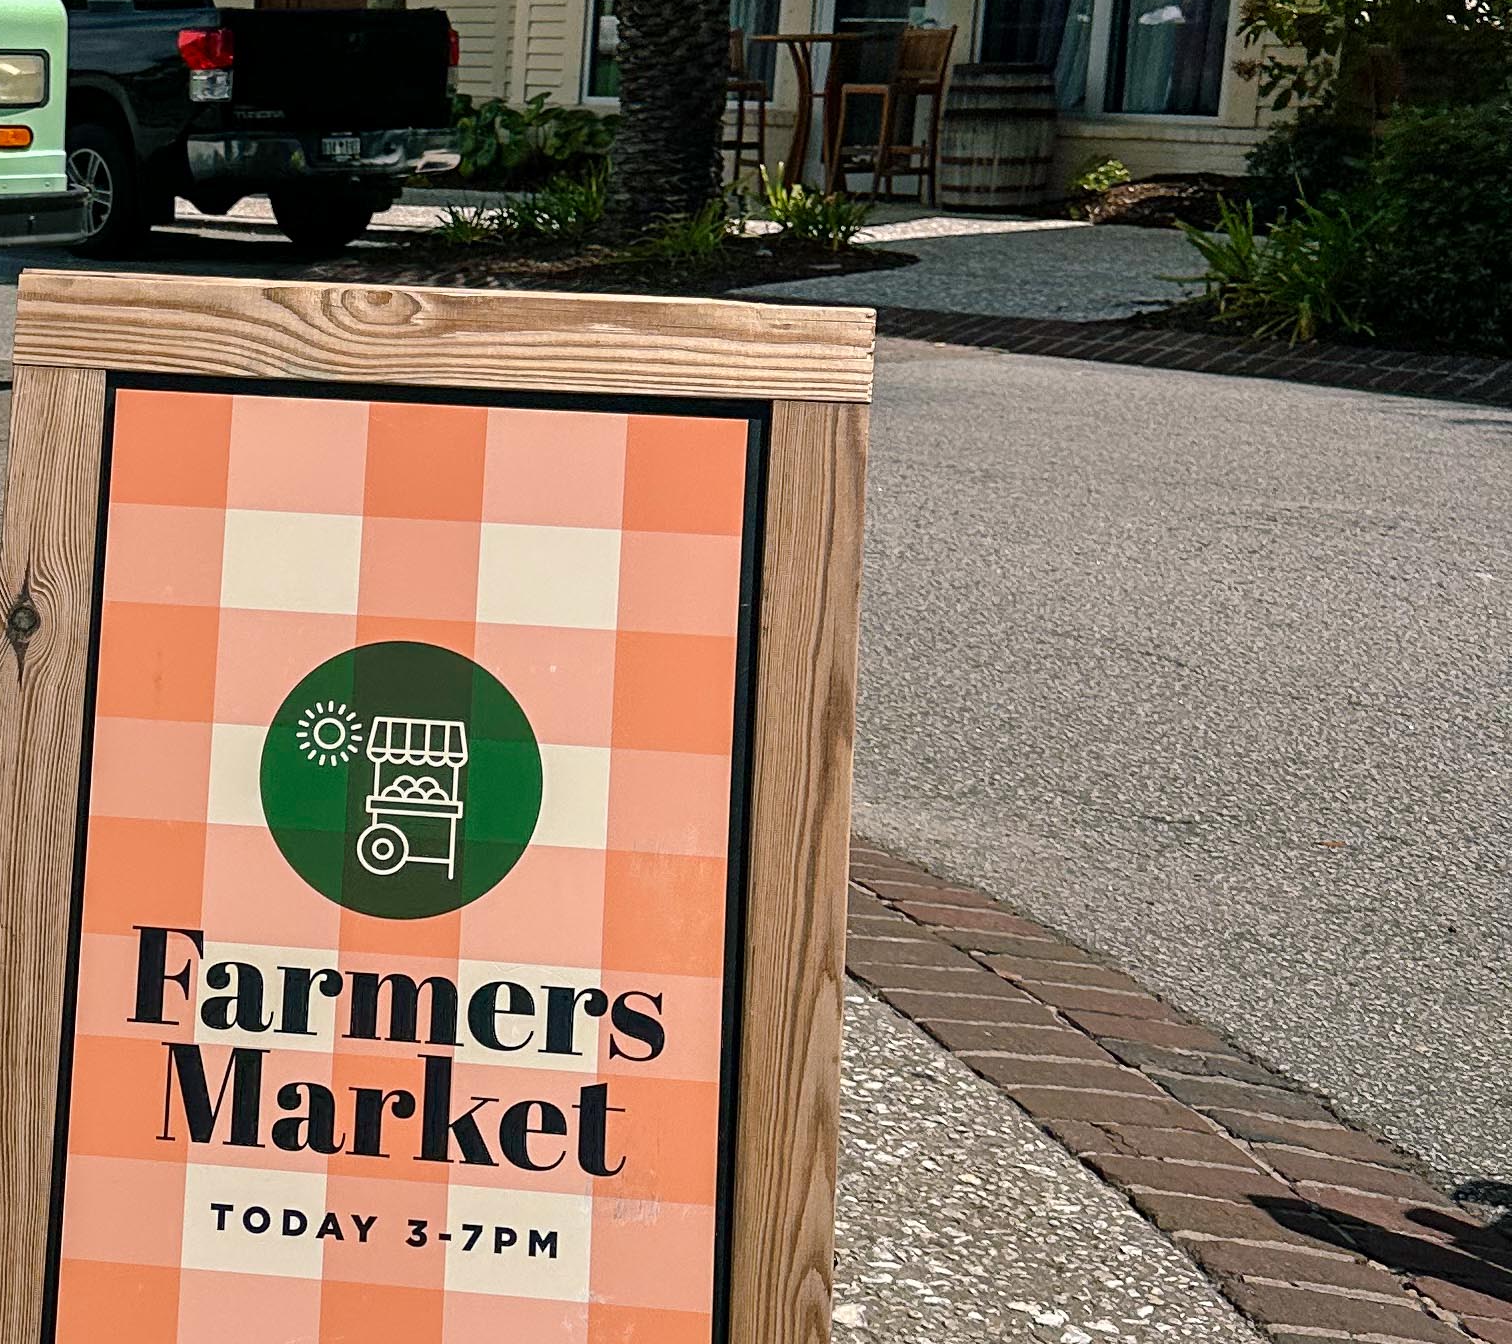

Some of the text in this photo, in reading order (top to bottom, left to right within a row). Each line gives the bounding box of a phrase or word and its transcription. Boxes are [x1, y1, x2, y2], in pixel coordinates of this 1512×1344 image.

[126, 925, 666, 1062] Farmers
[155, 1041, 627, 1177] Market
[210, 1202, 558, 1259] TODAY 3-7PM
